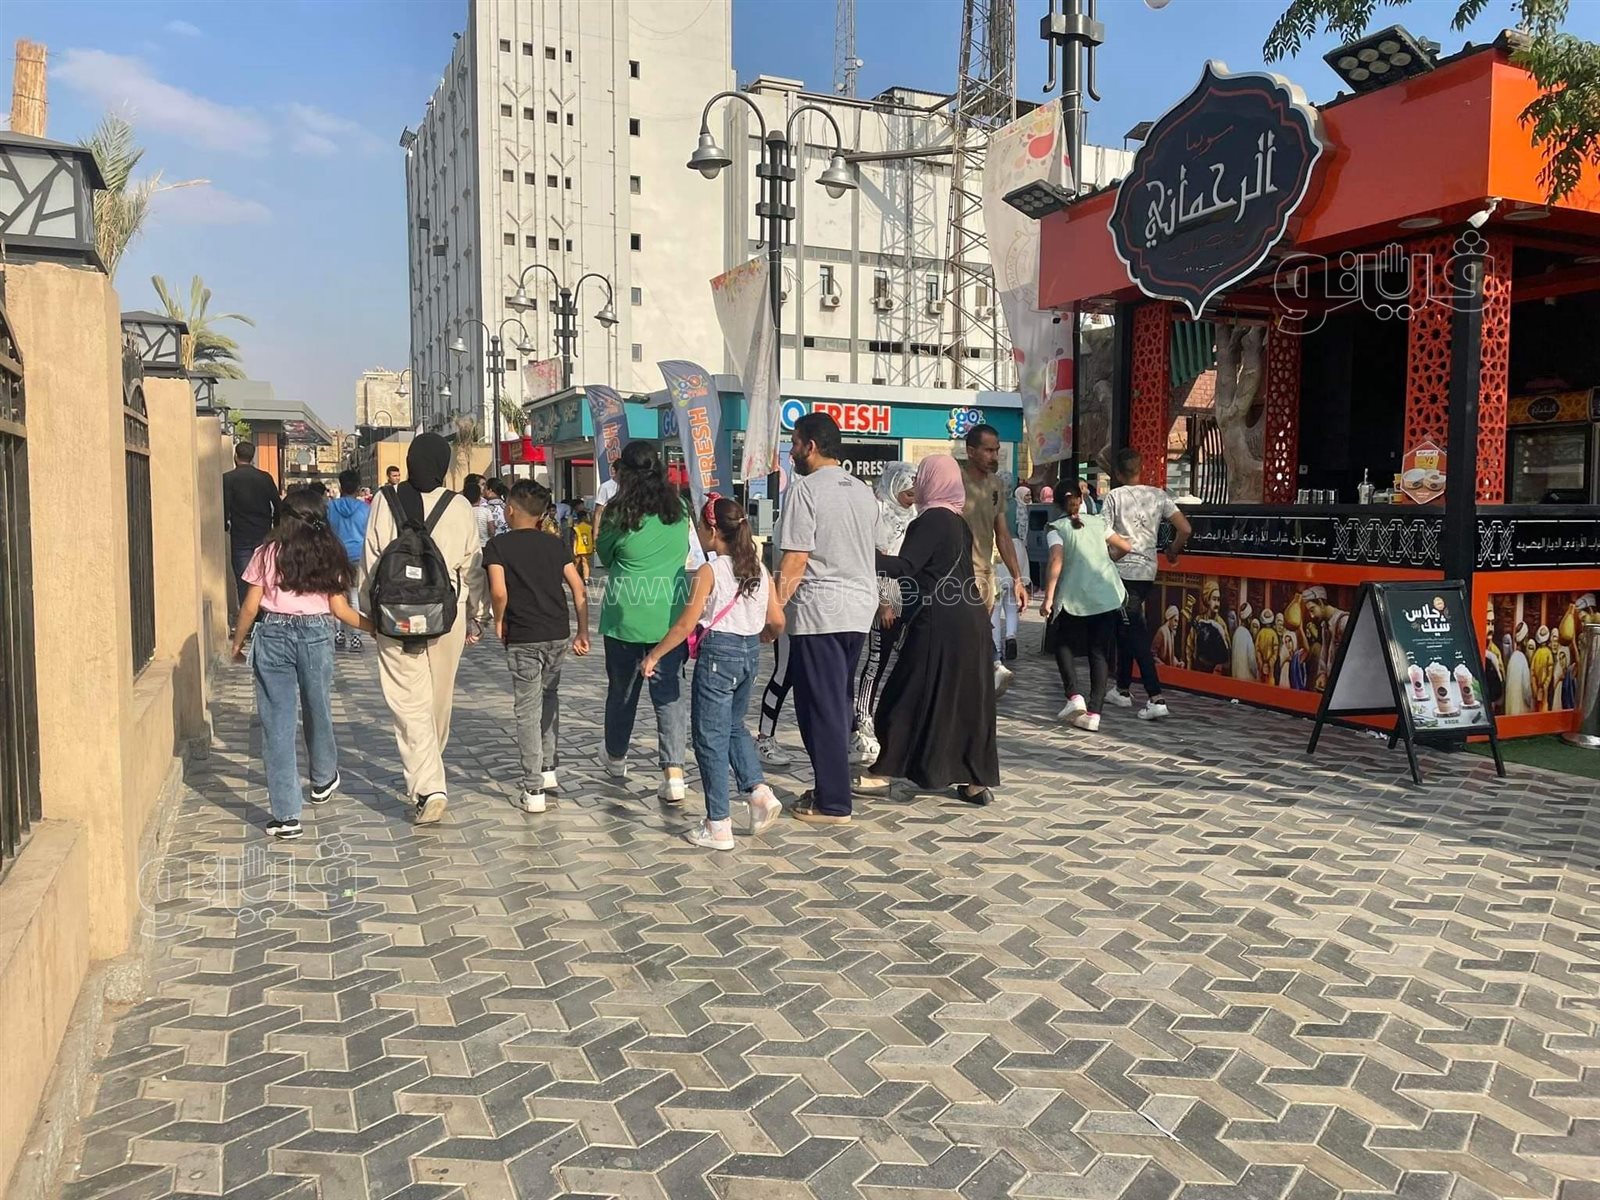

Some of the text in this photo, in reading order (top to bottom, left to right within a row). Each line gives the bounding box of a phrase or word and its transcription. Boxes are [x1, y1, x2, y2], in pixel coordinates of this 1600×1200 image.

[1145, 129, 1279, 249] الرحماني
[780, 398, 807, 431] O
[687, 406, 720, 489] FRESH
[856, 460, 887, 476] FRES
[1405, 603, 1440, 623] جلاس
[1421, 615, 1451, 636] شيك
